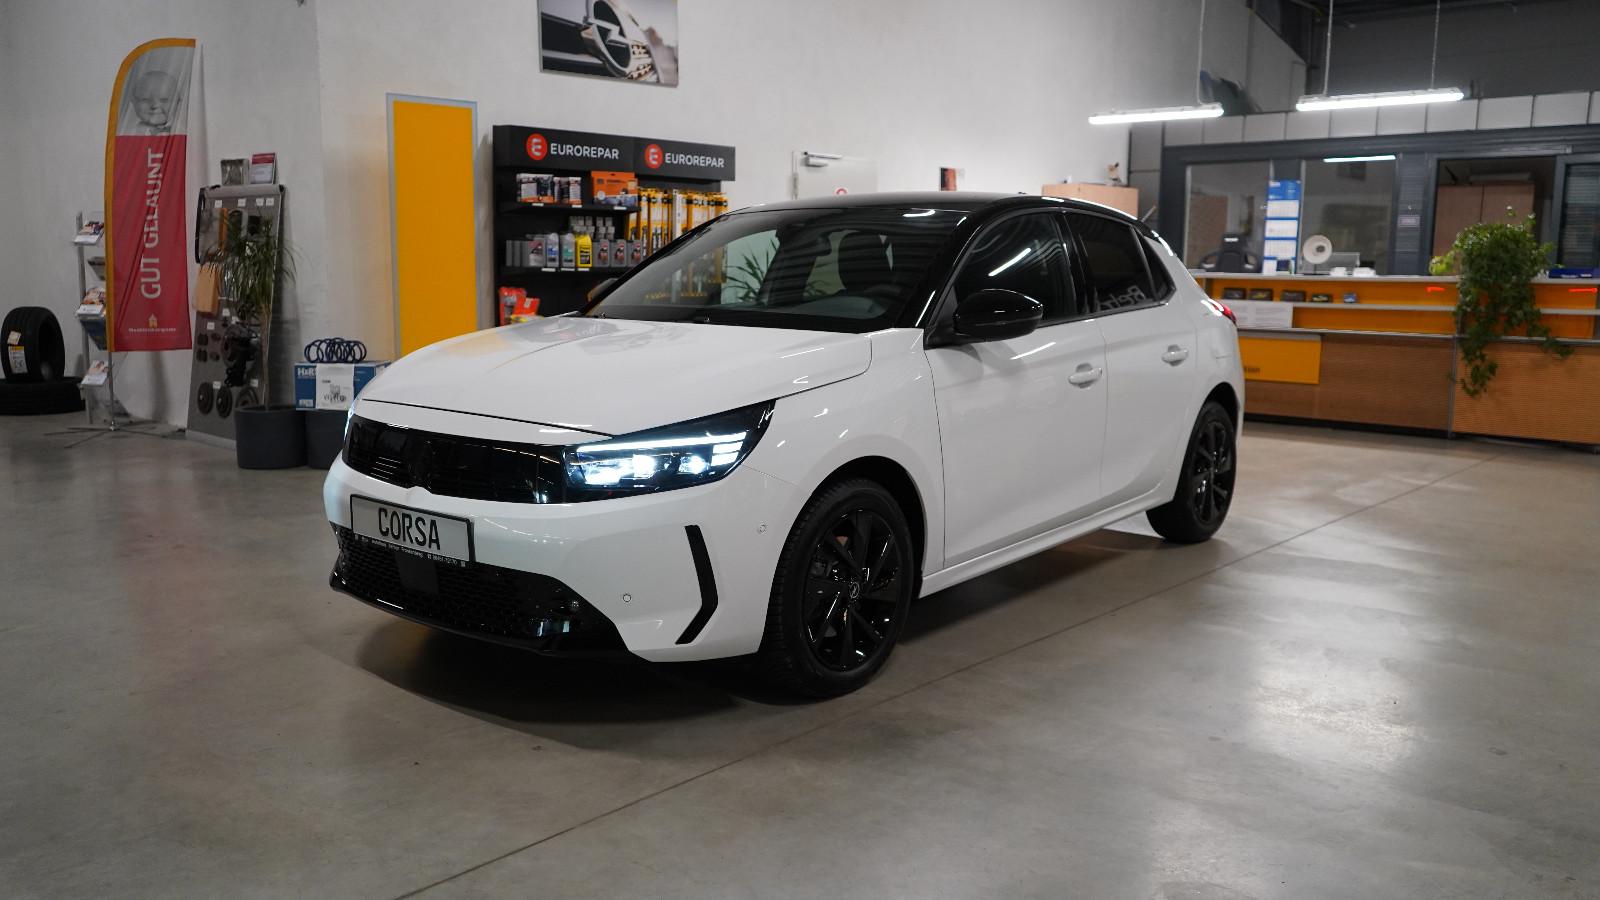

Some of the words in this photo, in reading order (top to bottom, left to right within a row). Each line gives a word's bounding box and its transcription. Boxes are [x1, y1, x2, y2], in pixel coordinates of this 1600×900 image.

[550, 143, 620, 160] EUROREPAR
[665, 152, 725, 168] EUROREPAR
[144, 147, 164, 249] GELAUNT
[141, 254, 162, 299] GUT
[378, 507, 441, 551] CORSA
